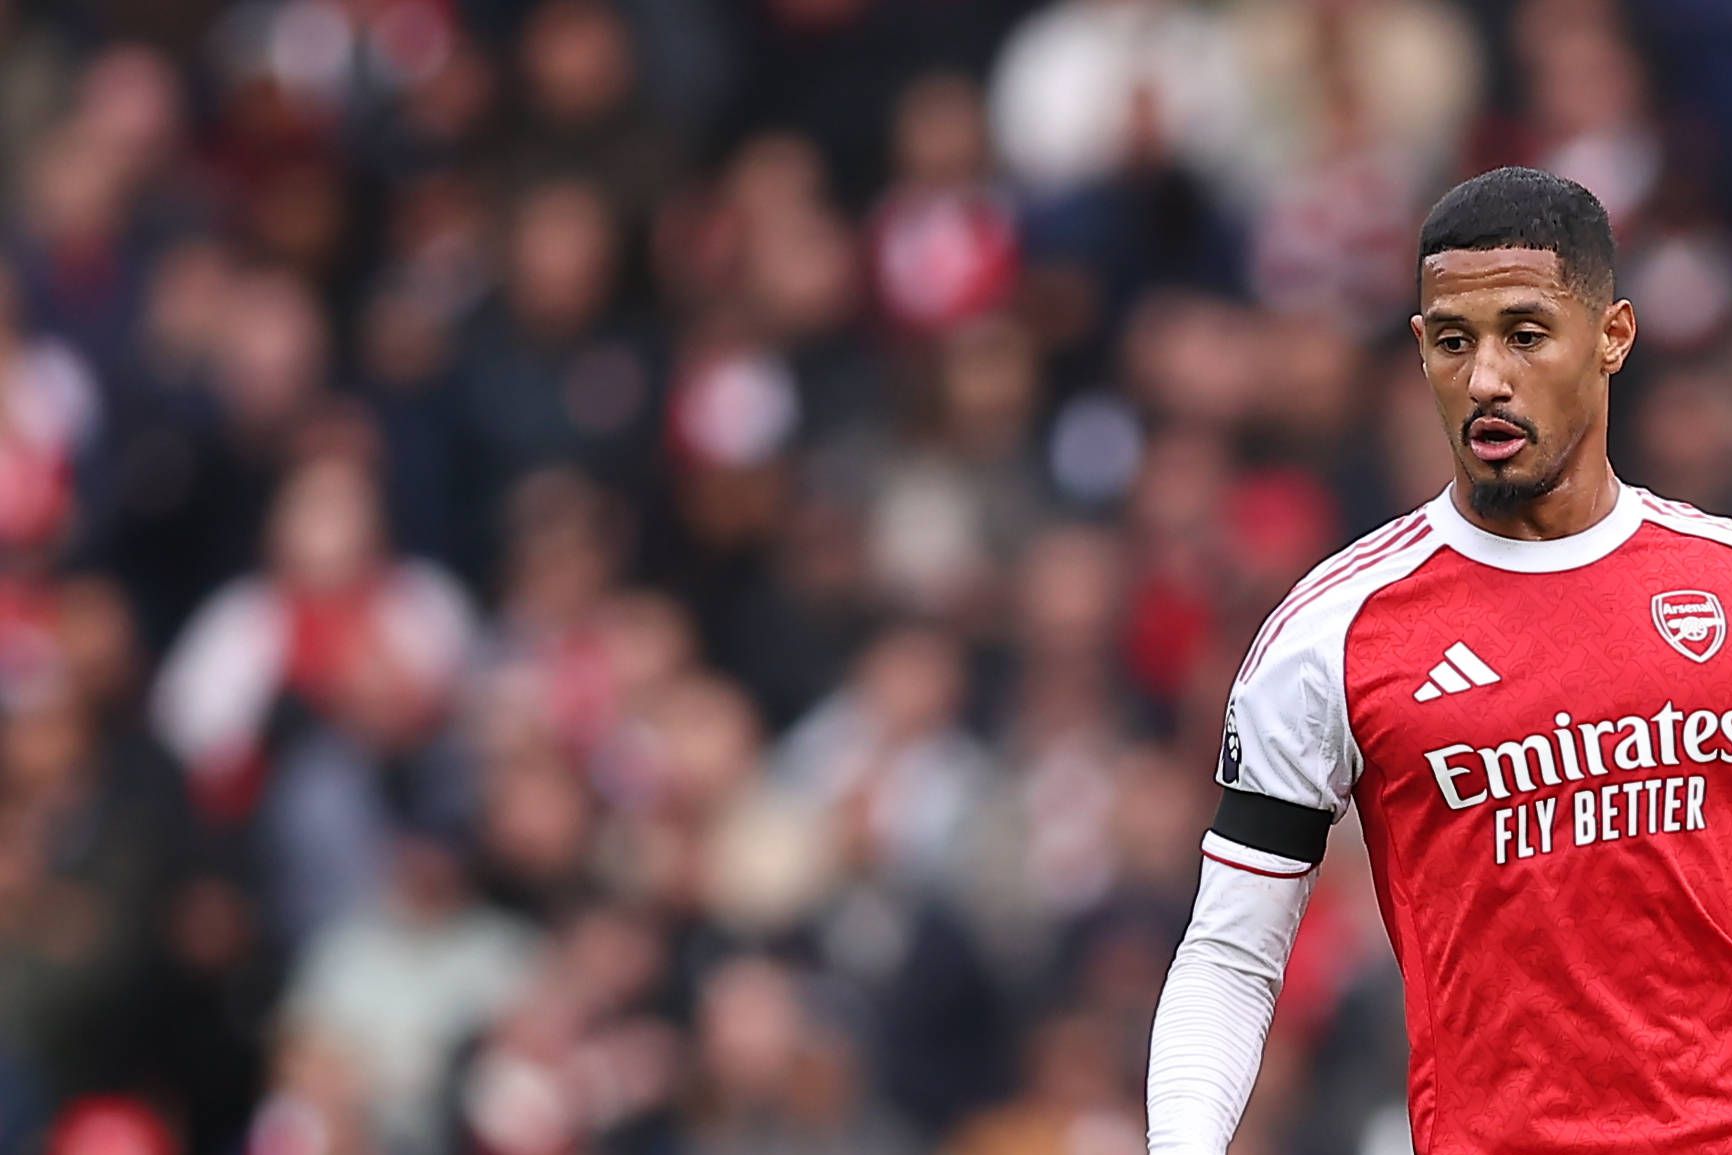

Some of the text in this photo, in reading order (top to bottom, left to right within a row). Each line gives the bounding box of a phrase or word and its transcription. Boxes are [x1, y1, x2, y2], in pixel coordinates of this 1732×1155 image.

[1662, 602, 1714, 615] Arsenal
[1495, 775, 1707, 865] FLY BETTER
